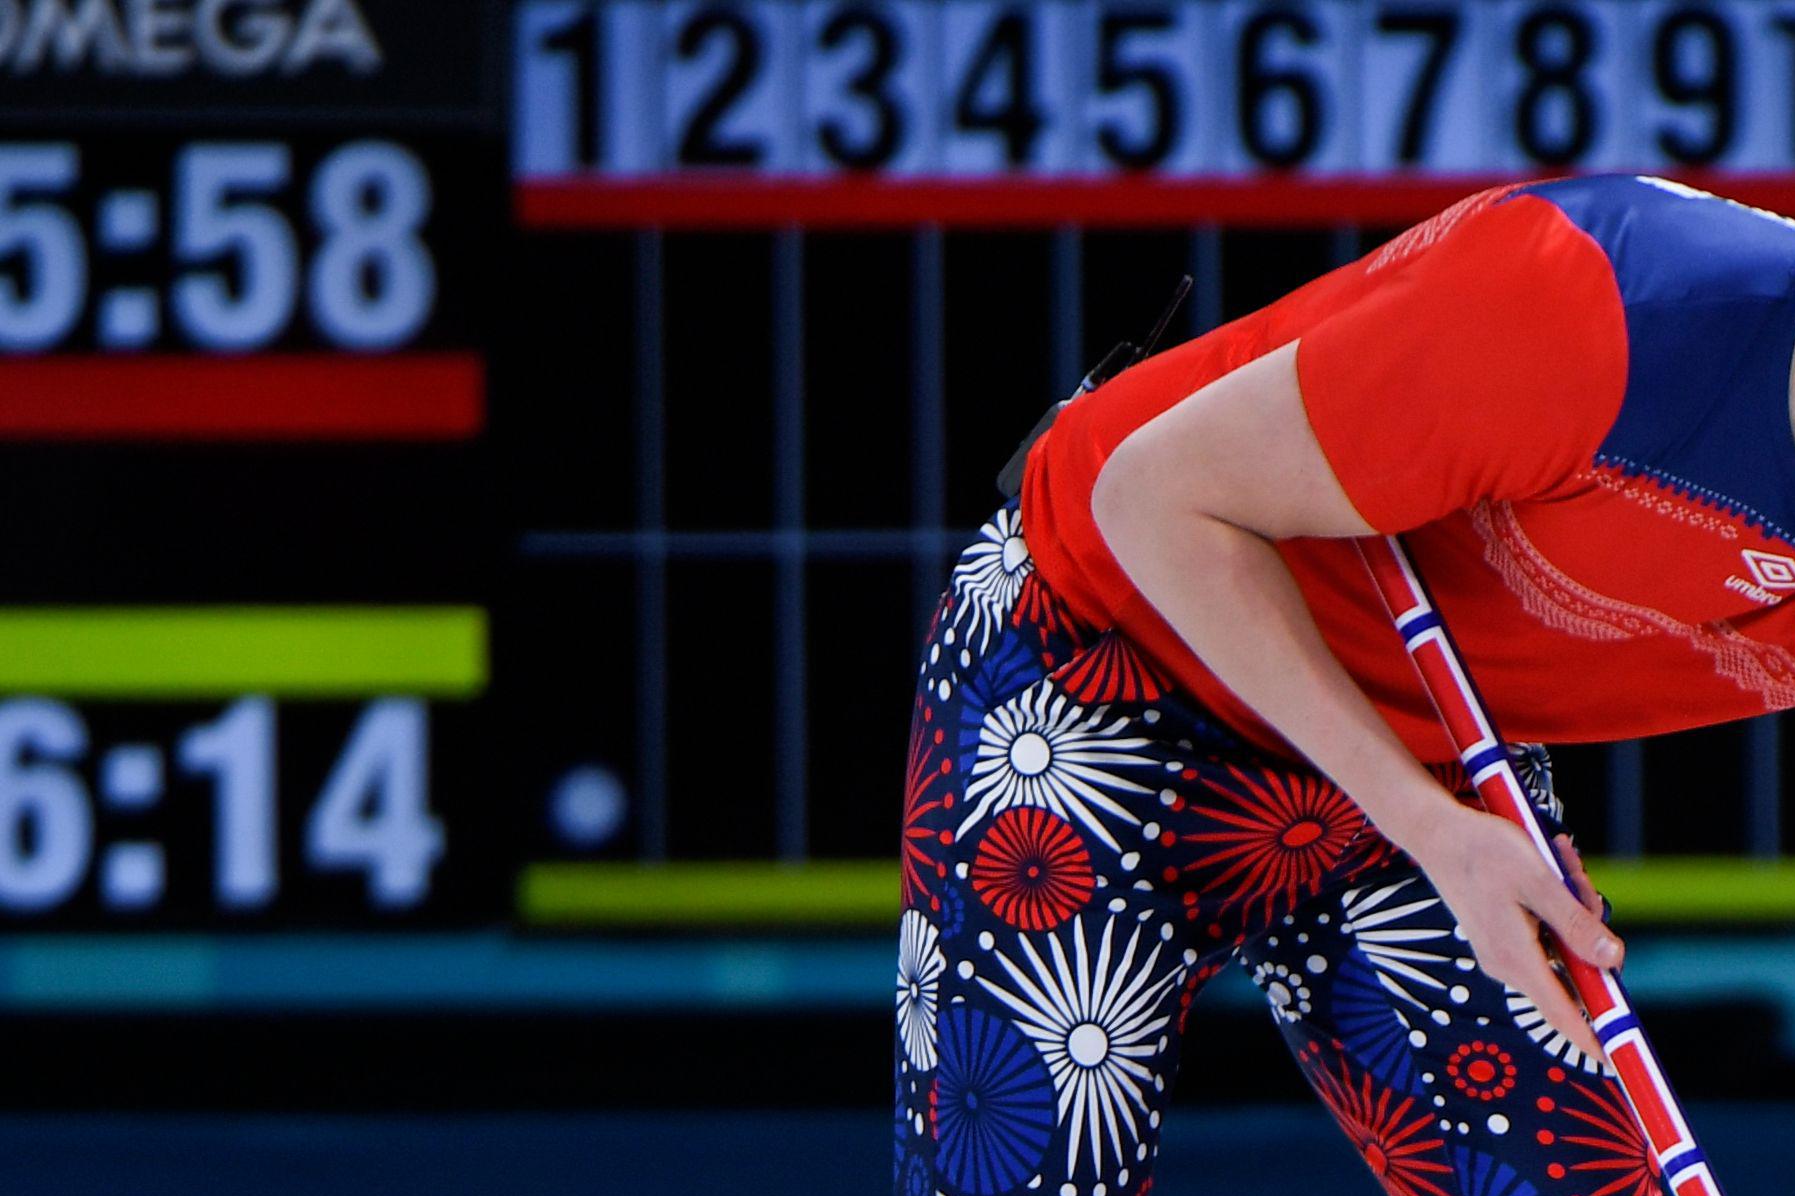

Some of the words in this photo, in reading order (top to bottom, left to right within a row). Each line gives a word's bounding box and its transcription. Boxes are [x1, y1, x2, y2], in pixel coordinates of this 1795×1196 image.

[0, 0, 380, 74] MEGA
[538, 12, 605, 168] 1
[672, 12, 765, 168] 2
[815, 12, 905, 168] 3
[952, 12, 1046, 168] 4
[1094, 12, 1181, 168] 5
[1235, 12, 1325, 168] 6
[1375, 12, 1459, 168] 7
[1512, 12, 1597, 168] 8
[1652, 12, 1737, 168] 9
